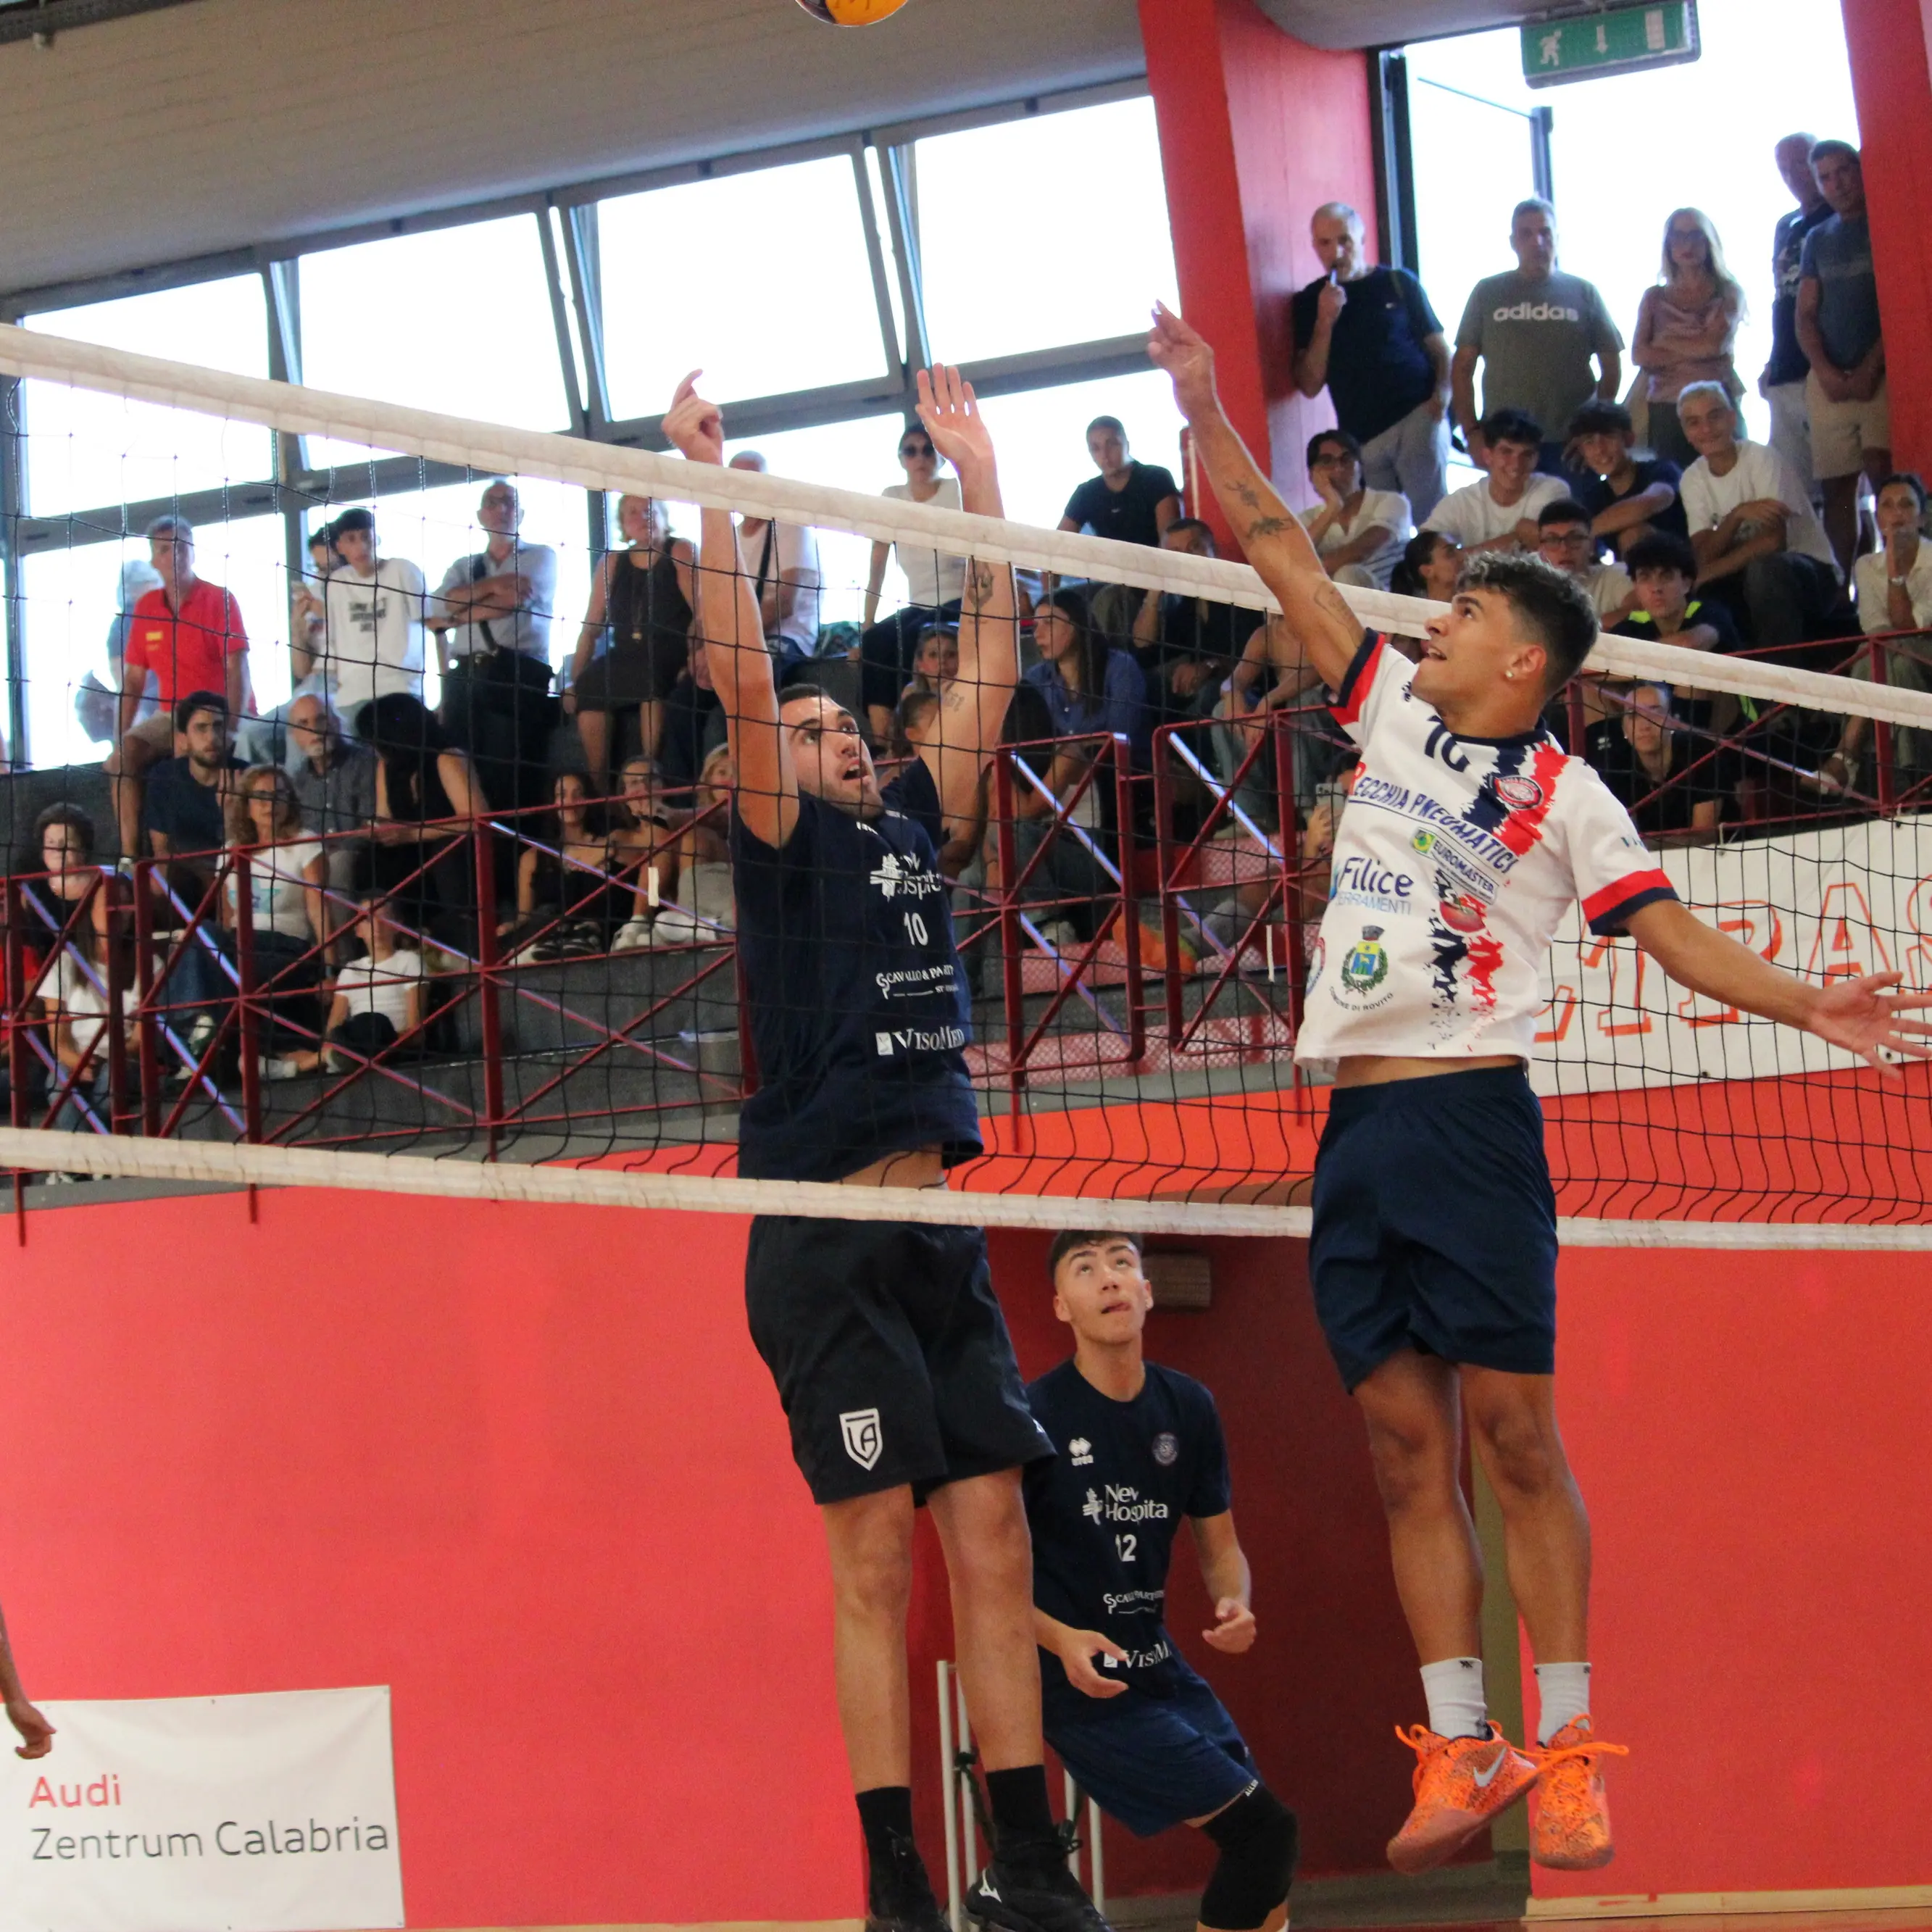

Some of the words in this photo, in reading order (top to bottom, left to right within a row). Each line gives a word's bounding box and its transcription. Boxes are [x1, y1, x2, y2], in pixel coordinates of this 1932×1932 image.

[1493, 301, 1579, 321] adidas
[1338, 857, 1415, 897] Filice
[1433, 839, 1494, 894] EUROMASTER
[1336, 891, 1412, 915] ERRAMENTI
[904, 912, 928, 946] 10
[1362, 991, 1394, 1011] ROVITO
[1104, 1499, 1168, 1525] Hospita
[1115, 1533, 1137, 1562] 12
[29, 1774, 122, 1808] Audi
[30, 1827, 204, 1860] Zentrum
[215, 1816, 389, 1857] Calabria
